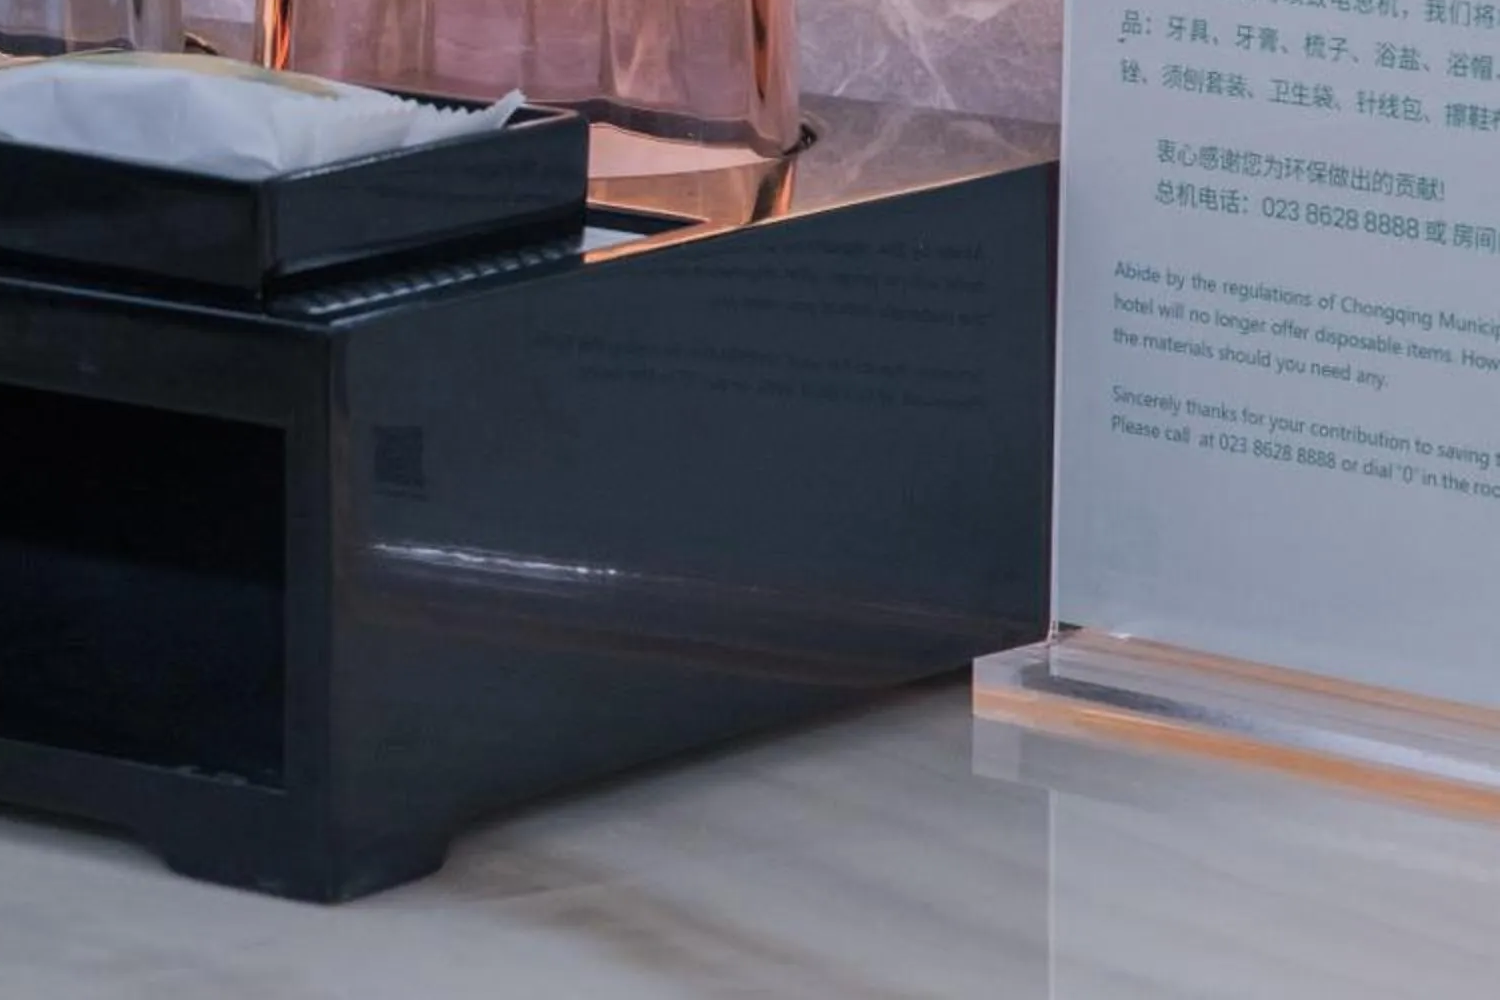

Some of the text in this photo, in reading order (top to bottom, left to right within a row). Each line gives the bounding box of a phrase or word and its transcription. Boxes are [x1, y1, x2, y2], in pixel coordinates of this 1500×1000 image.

[1262, 196, 1299, 222] 023
[1305, 203, 1359, 231] 8628
[1364, 211, 1419, 240] 8888
[1426, 219, 1447, 246] 或
[1453, 223, 1500, 255] 房间
[1114, 261, 1160, 283] Abide
[1166, 269, 1185, 290] by
[1191, 274, 1216, 293] the
[1223, 281, 1311, 307] regulations
[1318, 293, 1337, 310] of
[1341, 296, 1432, 331] Chongqing
[1114, 292, 1153, 314] hotel
[1158, 302, 1185, 319] will
[1189, 308, 1210, 324] no
[1215, 310, 1266, 335] longer
[1271, 318, 1308, 340] offer
[1315, 327, 1402, 354] disposable
[1113, 327, 1138, 346] the
[1143, 334, 1214, 358] materials
[1219, 345, 1271, 368] should
[1275, 355, 1306, 375] you
[1311, 361, 1350, 382] need
[1111, 414, 1160, 439] Please
[1165, 425, 1190, 444] call
[1198, 433, 1215, 448] at
[1219, 432, 1247, 453] 023
[1252, 438, 1292, 462] 8628
[1297, 447, 1336, 470] 8888
[1341, 458, 1358, 472] or
[1363, 458, 1393, 479] dial
[1422, 469, 1437, 487] in
[1442, 471, 1470, 493] the
[1113, 384, 1181, 416] Sincerely
[1186, 400, 1237, 422] thanks
[1242, 408, 1264, 426] for
[1269, 415, 1306, 435] your
[1310, 421, 1411, 451] contribution
[1414, 437, 1434, 456] to
[1436, 444, 1490, 471] saving
